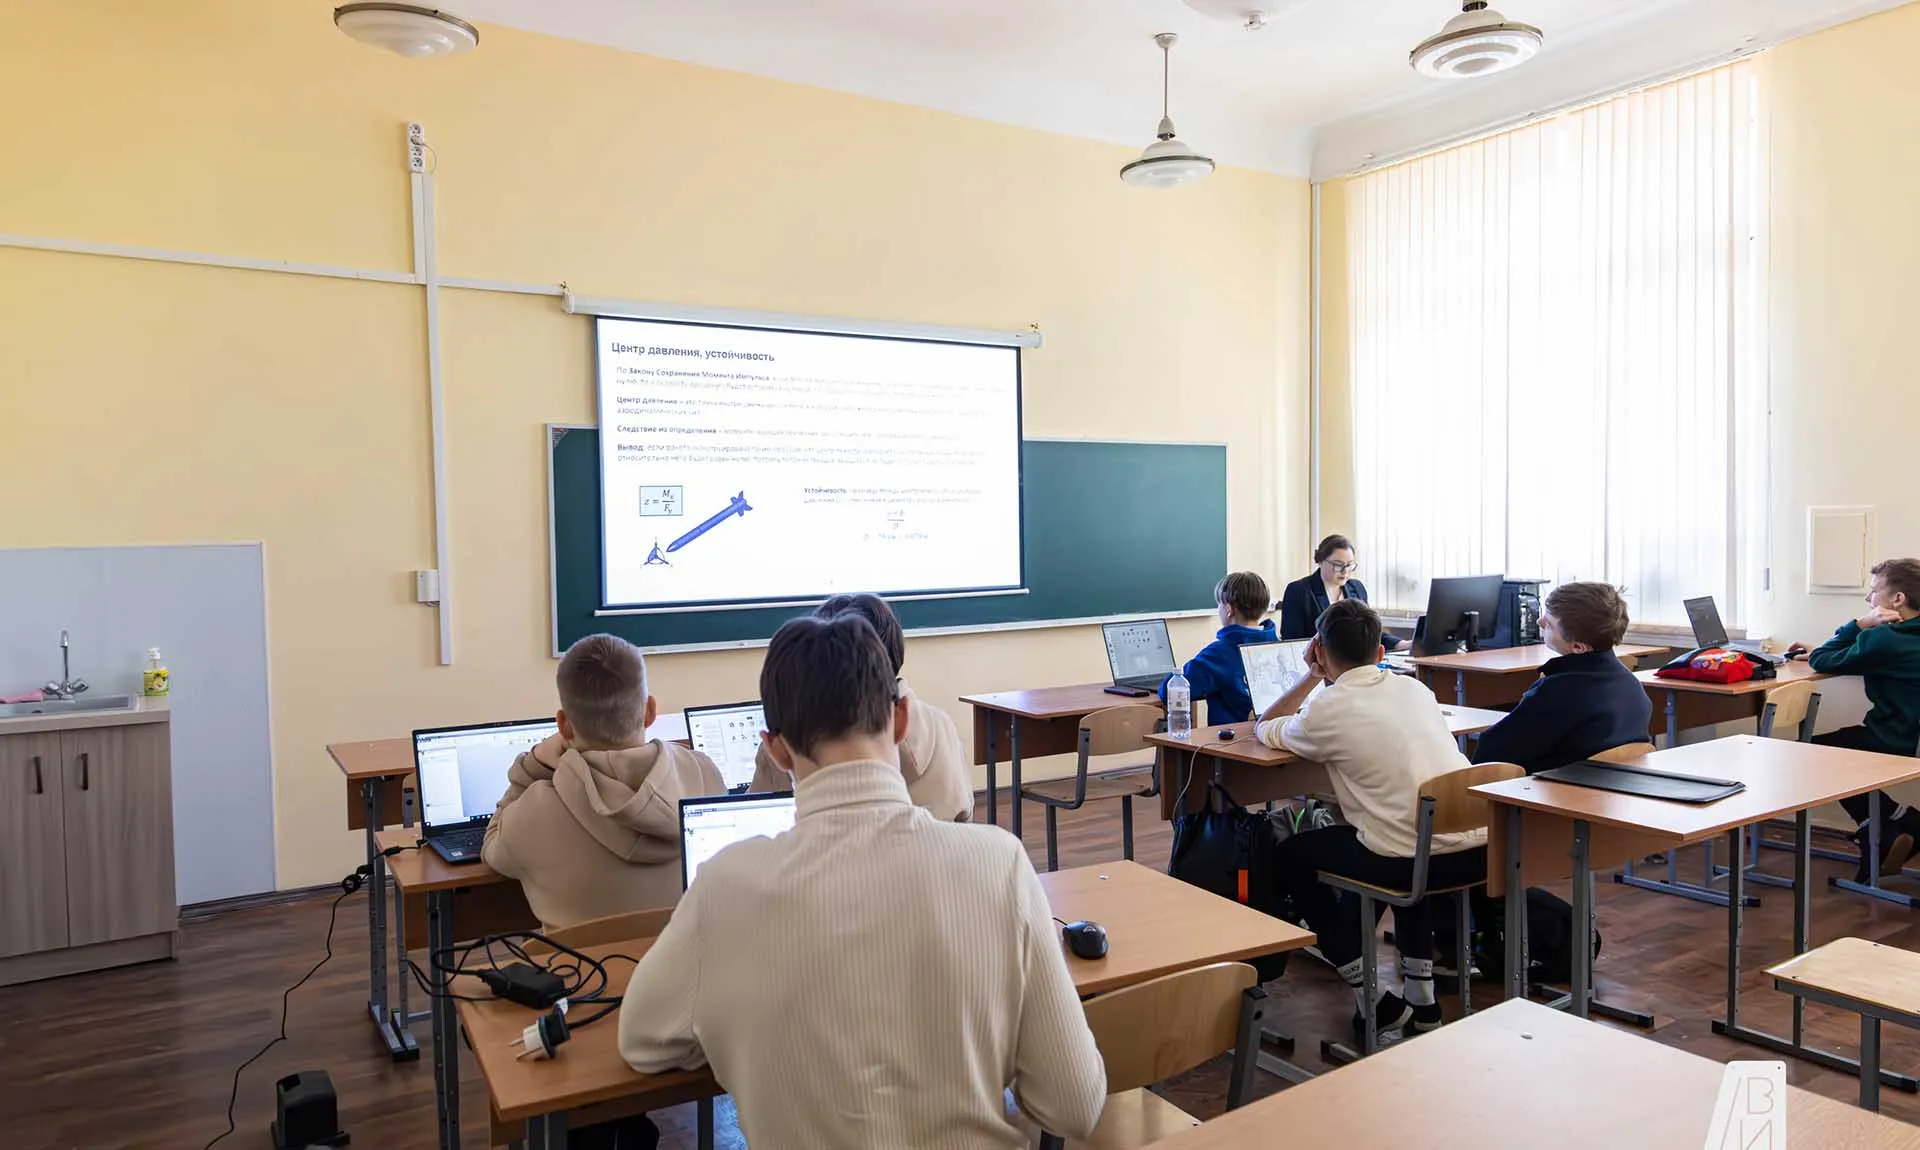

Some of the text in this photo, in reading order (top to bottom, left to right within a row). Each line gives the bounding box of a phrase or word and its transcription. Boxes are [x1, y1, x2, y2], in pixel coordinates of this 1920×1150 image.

[612, 342, 775, 362] Центр давления, устойчивость
[616, 425, 656, 433] Следствие
